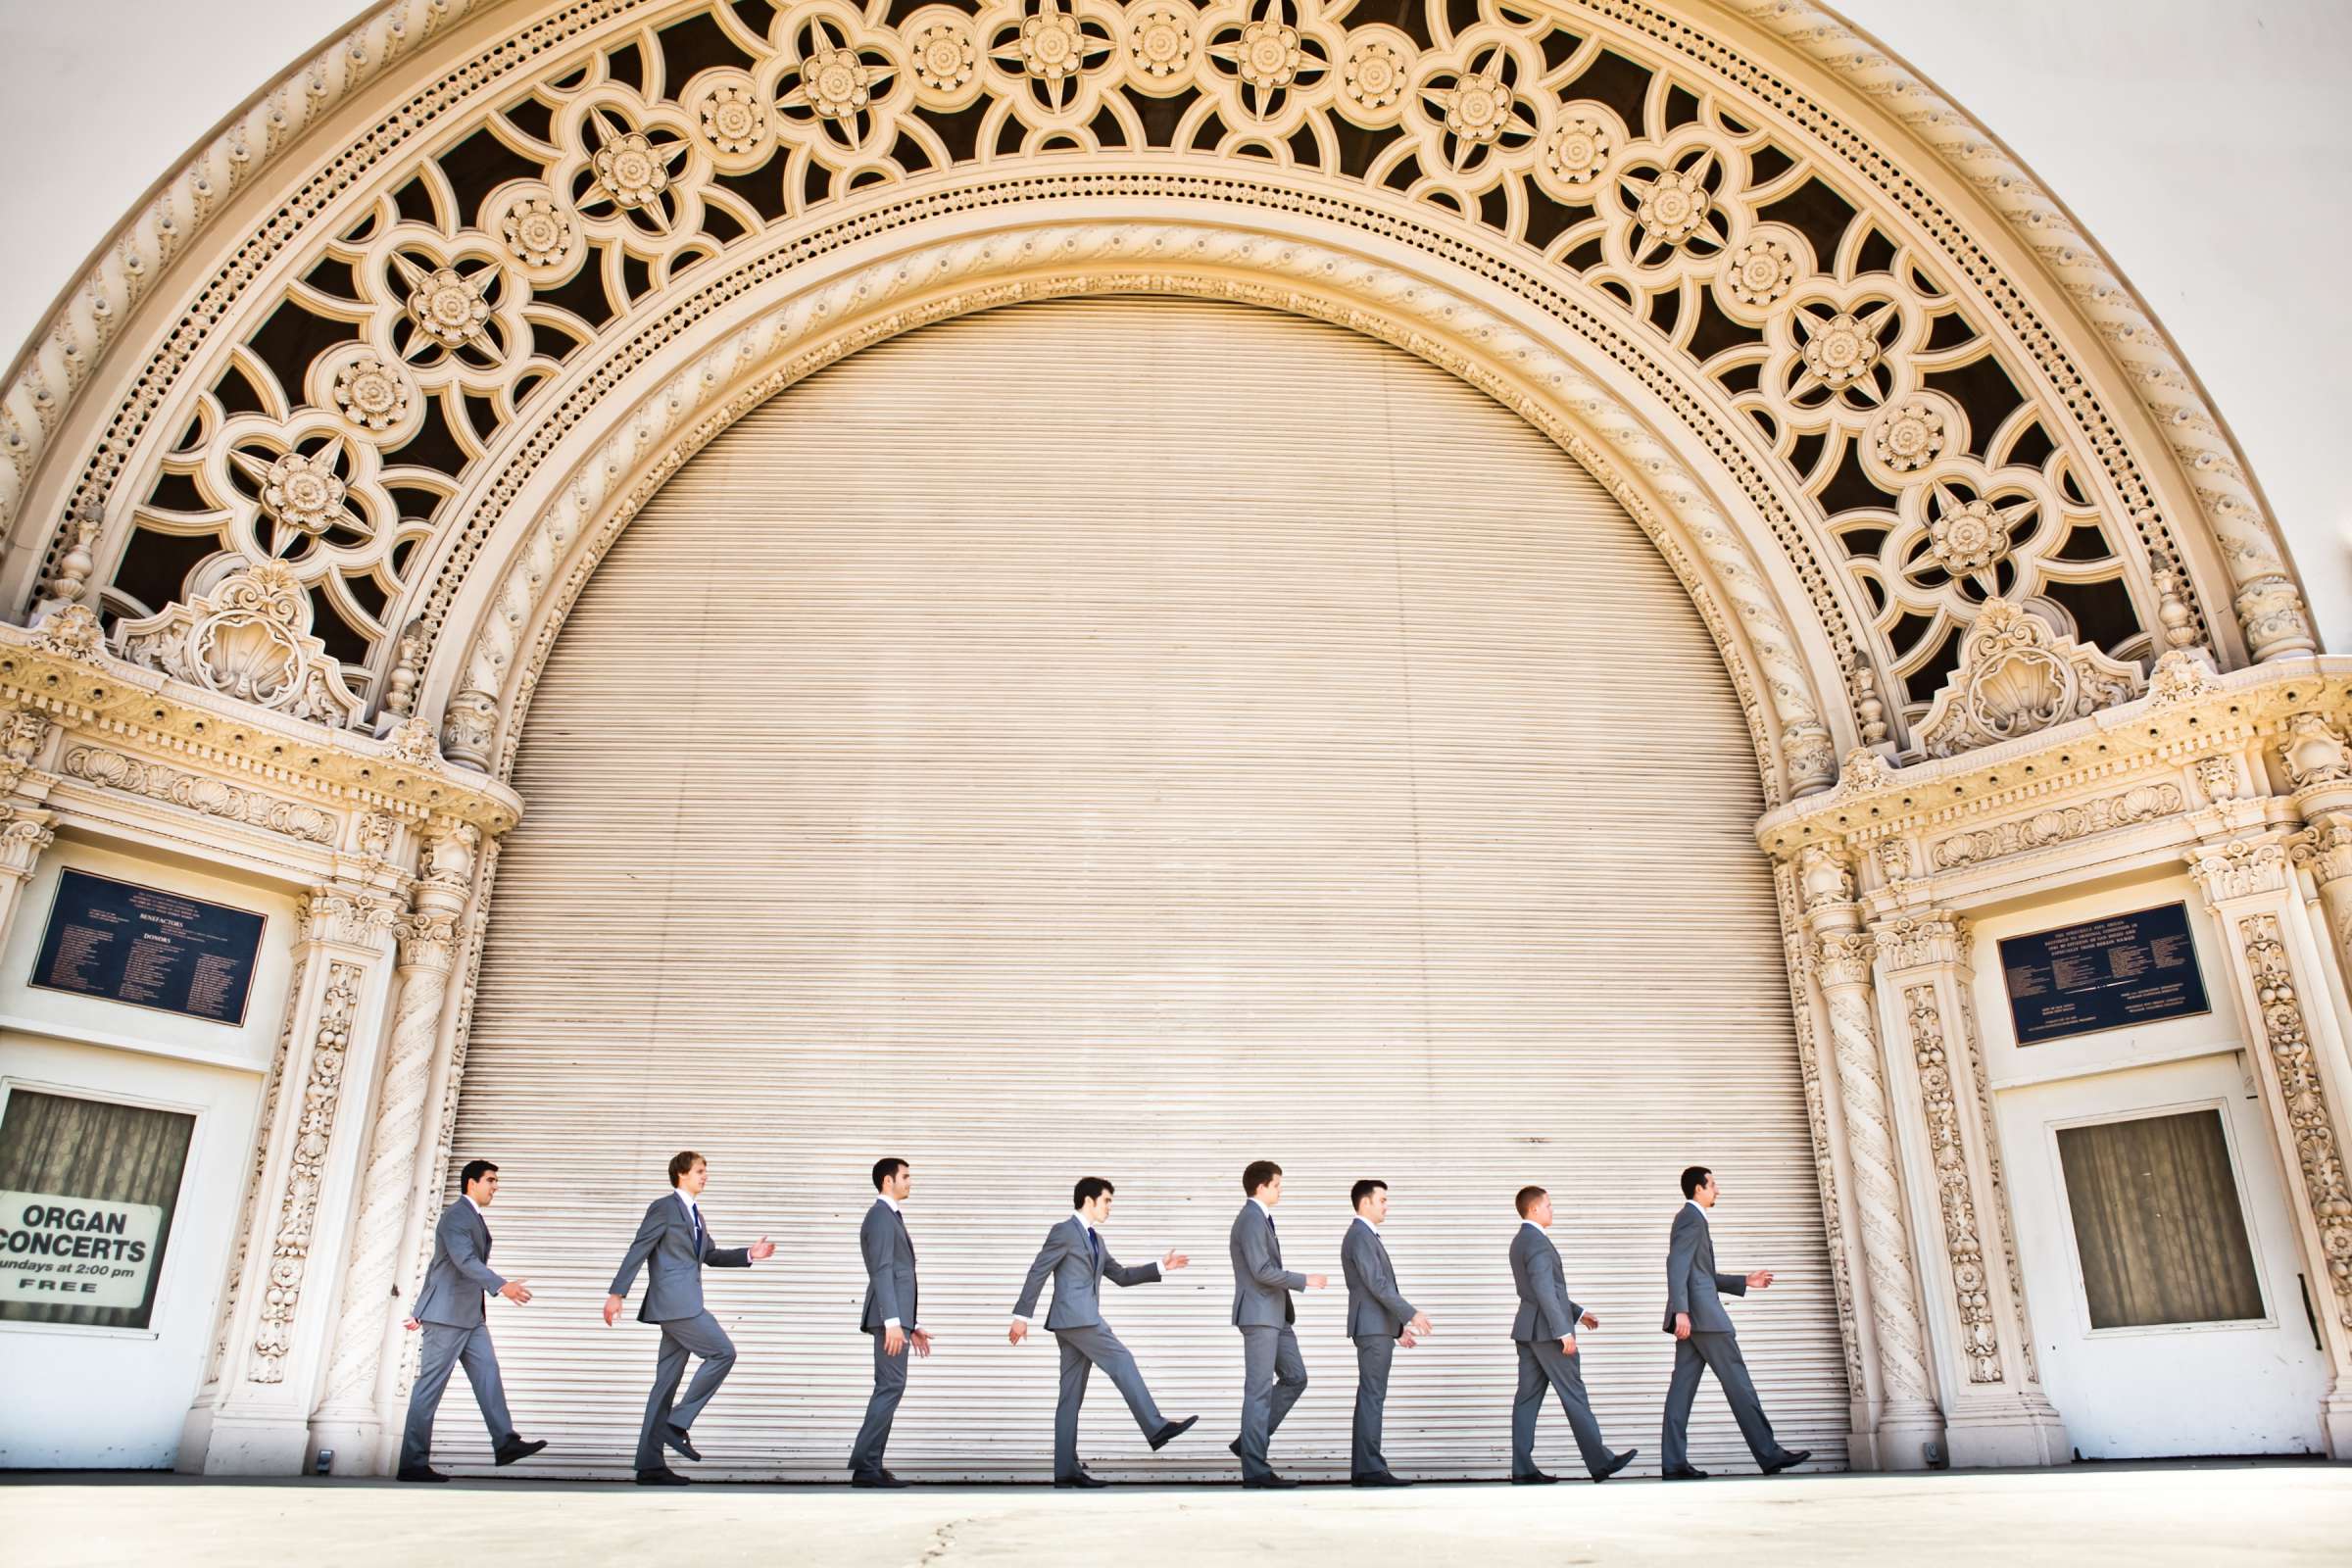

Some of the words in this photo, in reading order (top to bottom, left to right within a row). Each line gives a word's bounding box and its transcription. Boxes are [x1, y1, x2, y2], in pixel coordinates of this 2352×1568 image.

[139, 912, 183, 927] BENEFACTORS
[143, 932, 171, 944] DONORS
[23, 1204, 127, 1235] ORGAN
[0, 1259, 54, 1273] undays
[57, 1264, 74, 1274] at
[75, 1264, 110, 1276] 2:00
[111, 1268, 135, 1279] pm
[19, 1279, 98, 1293] FREE
